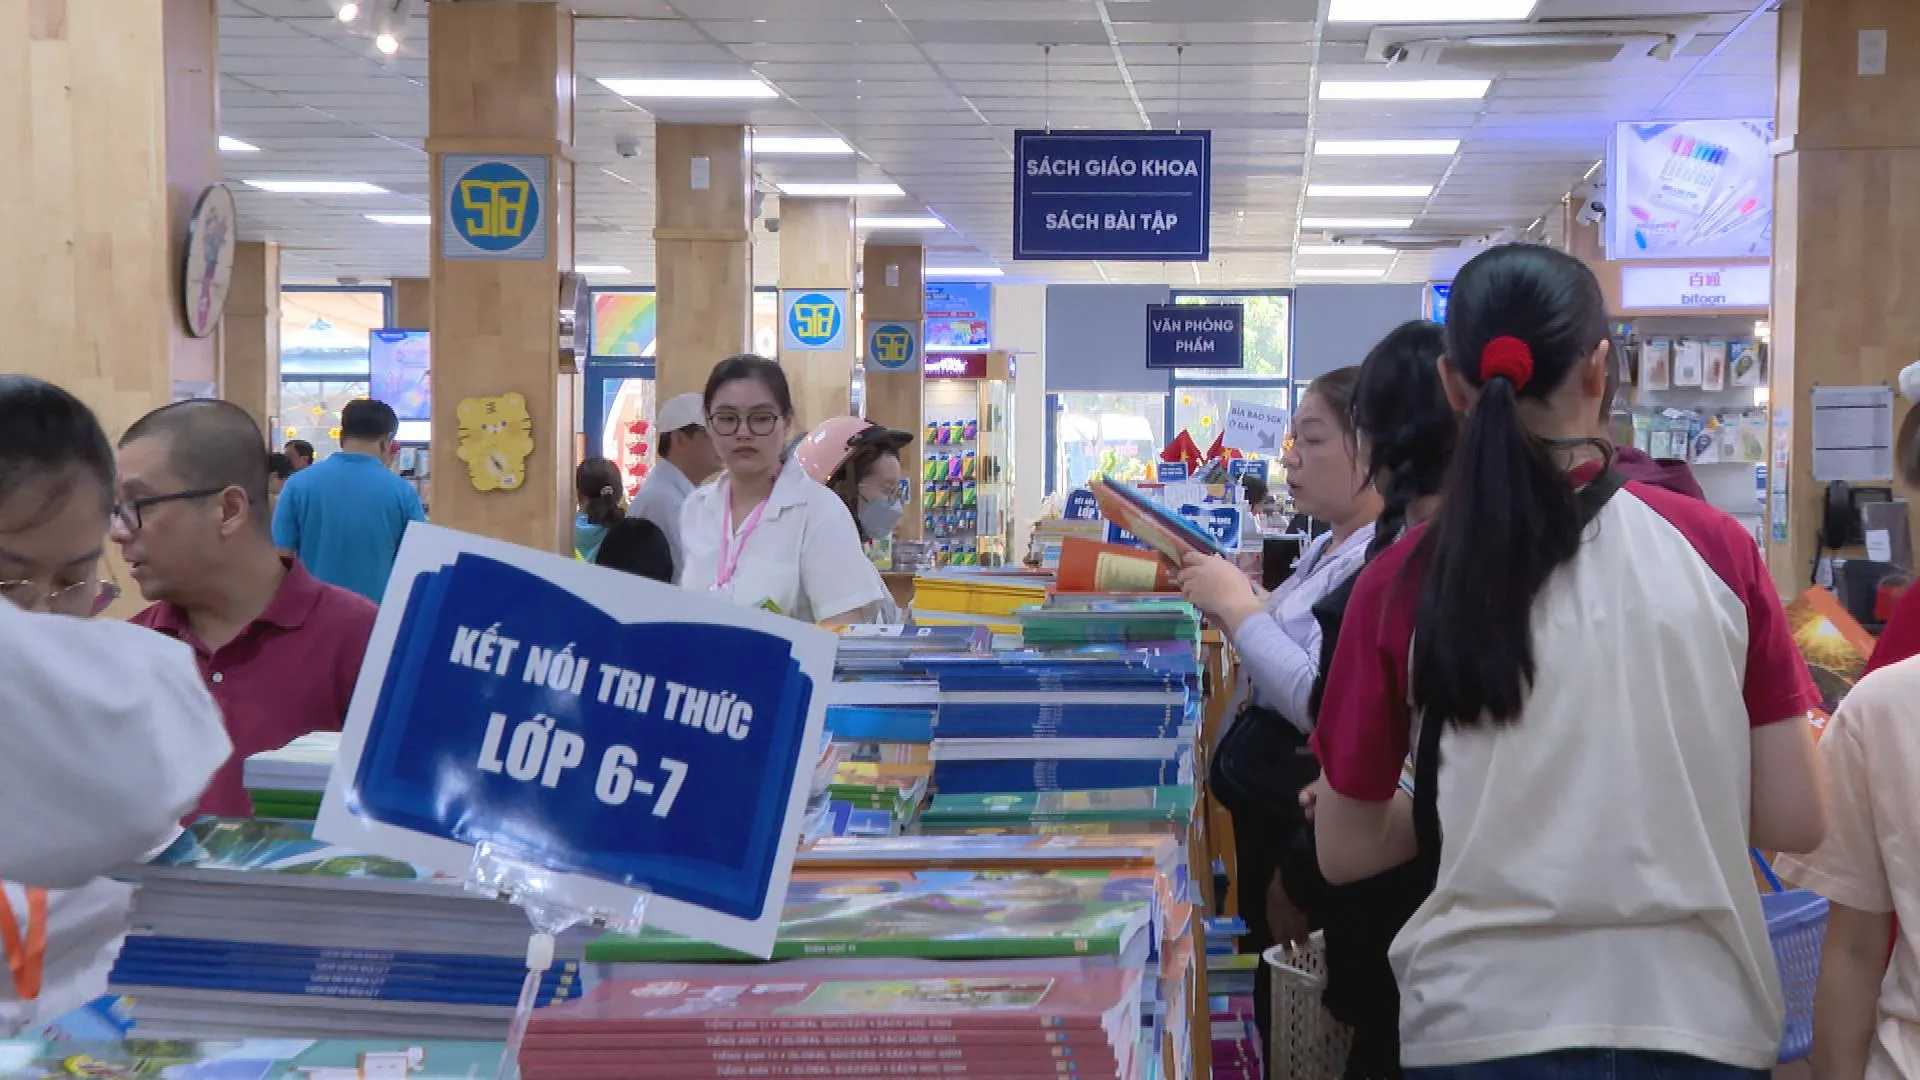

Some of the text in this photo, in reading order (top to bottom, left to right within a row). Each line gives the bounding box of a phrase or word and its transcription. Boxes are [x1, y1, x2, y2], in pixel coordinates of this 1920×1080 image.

[1026, 155, 1198, 176] SÁCH GIÁO KHOA
[1045, 209, 1178, 235] SÁCH BÀI TẬP
[1152, 317, 1234, 332] VĂN PHÒNG
[450, 622, 753, 741] KẾT NỐI TRI THỨC
[476, 712, 689, 819] LỚP 6-7
